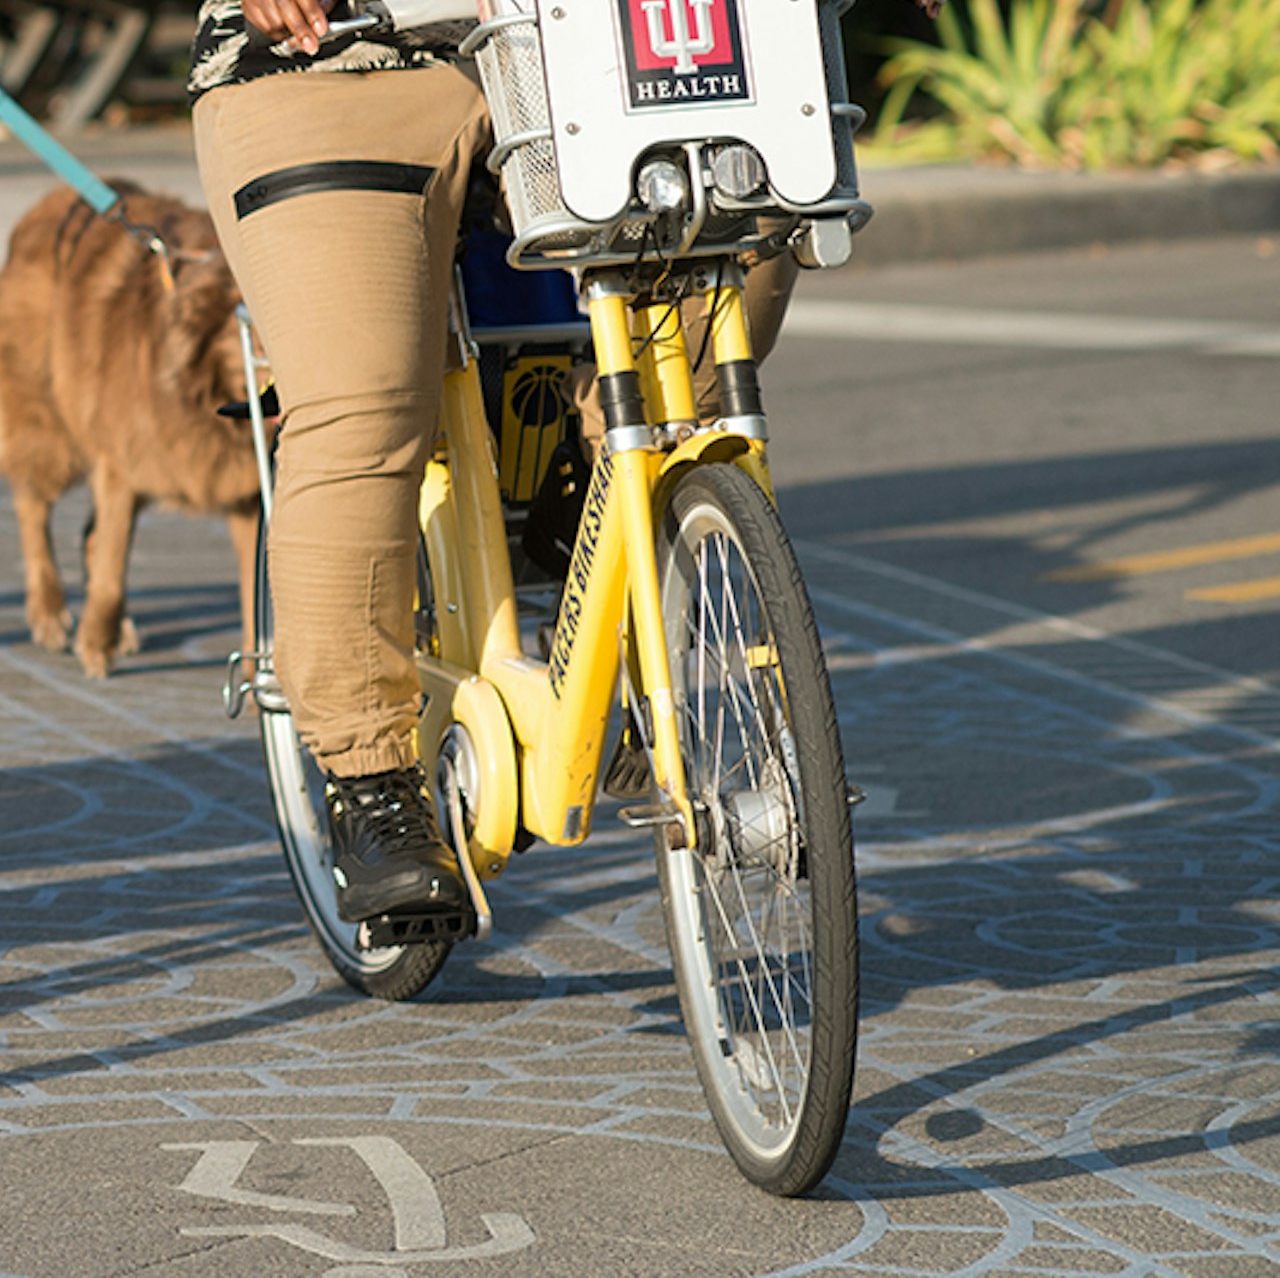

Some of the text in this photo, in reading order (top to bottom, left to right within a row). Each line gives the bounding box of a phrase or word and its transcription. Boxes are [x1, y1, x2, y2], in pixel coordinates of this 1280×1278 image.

[636, 75, 740, 101] HEALTH
[548, 444, 615, 701] PACERS BIKESHAR
